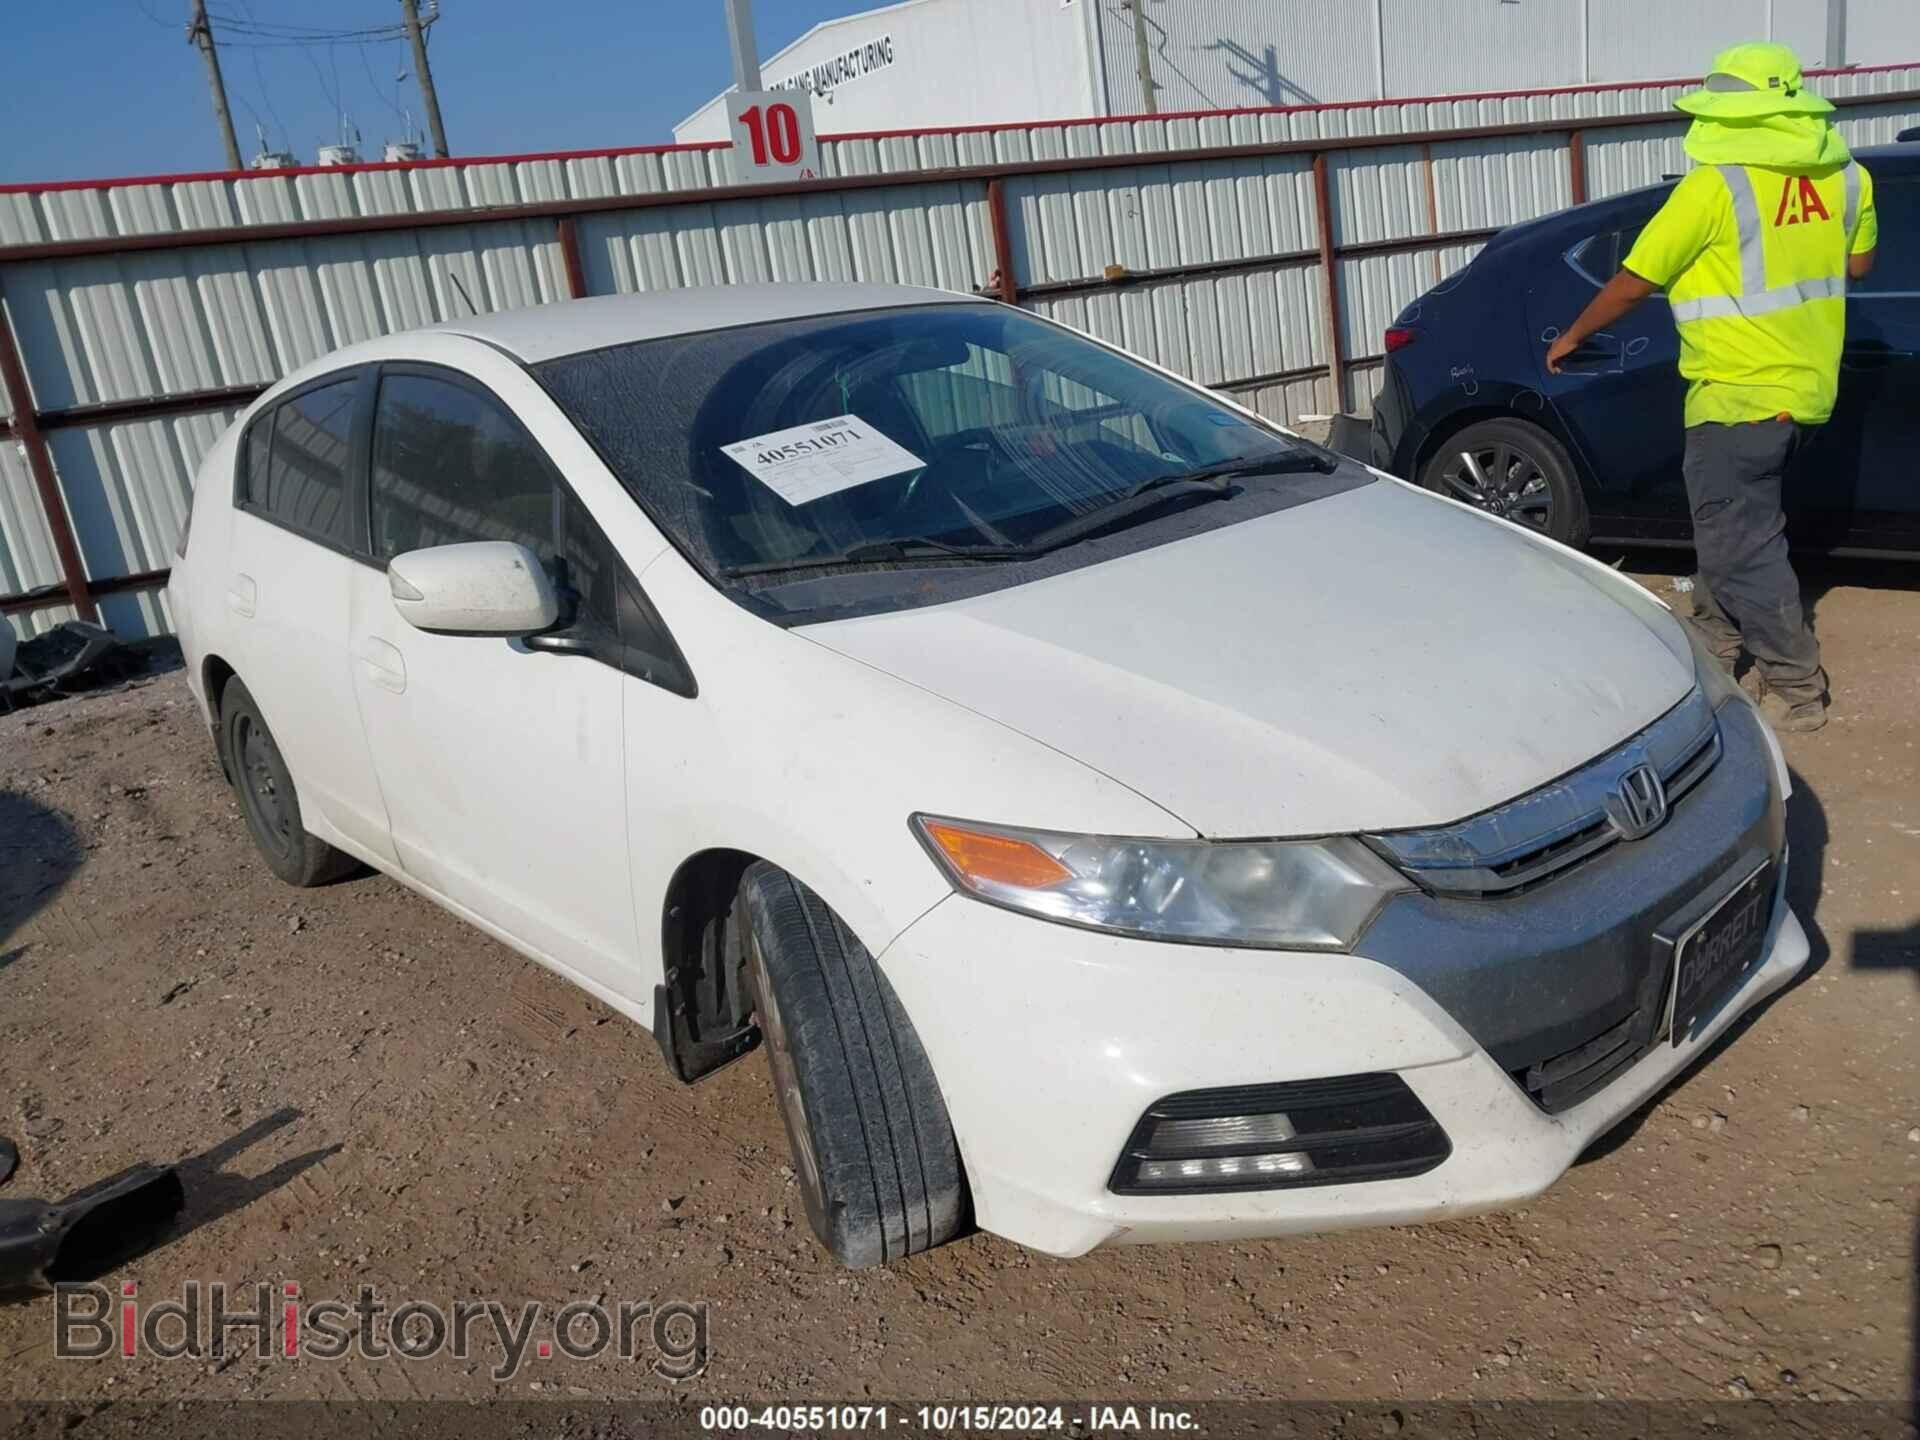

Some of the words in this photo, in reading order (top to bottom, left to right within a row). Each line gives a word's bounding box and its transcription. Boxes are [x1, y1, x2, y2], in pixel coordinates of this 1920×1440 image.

[812, 36, 893, 91] MANUFACTURING
[738, 103, 802, 165] 10
[757, 429, 863, 464] 40551071
